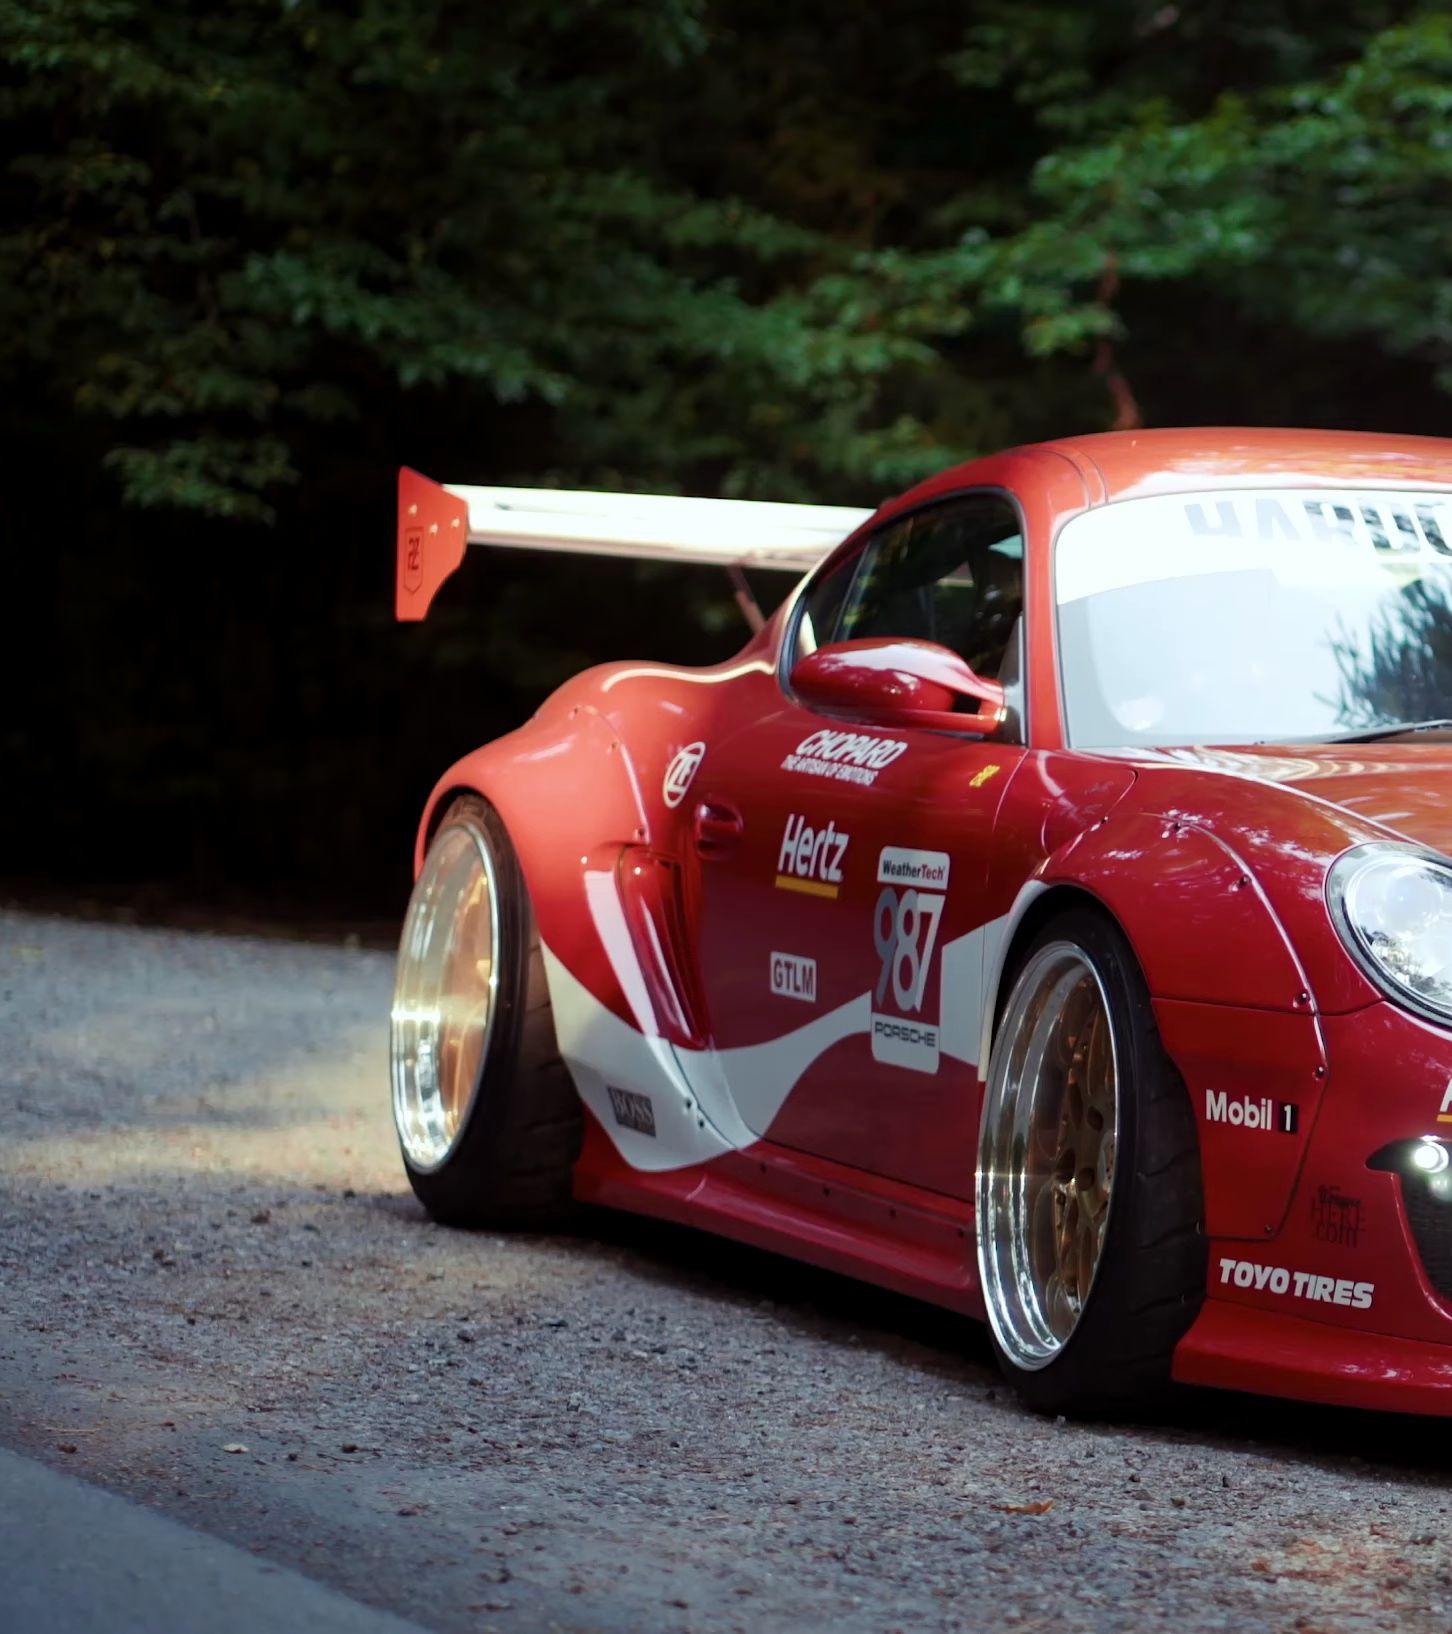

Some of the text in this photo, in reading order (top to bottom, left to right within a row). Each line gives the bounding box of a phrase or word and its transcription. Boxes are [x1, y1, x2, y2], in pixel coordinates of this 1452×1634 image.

[796, 729, 908, 769] CHOPARD
[777, 813, 850, 883] Hertz
[882, 859, 945, 881] WeatherTech
[873, 887, 946, 1013] 987
[773, 957, 814, 996] GTLM
[874, 1020, 936, 1048] PORSCHE
[1205, 1089, 1292, 1132] Mobil 1
[1219, 1258, 1375, 1309] TOYO TIRES
